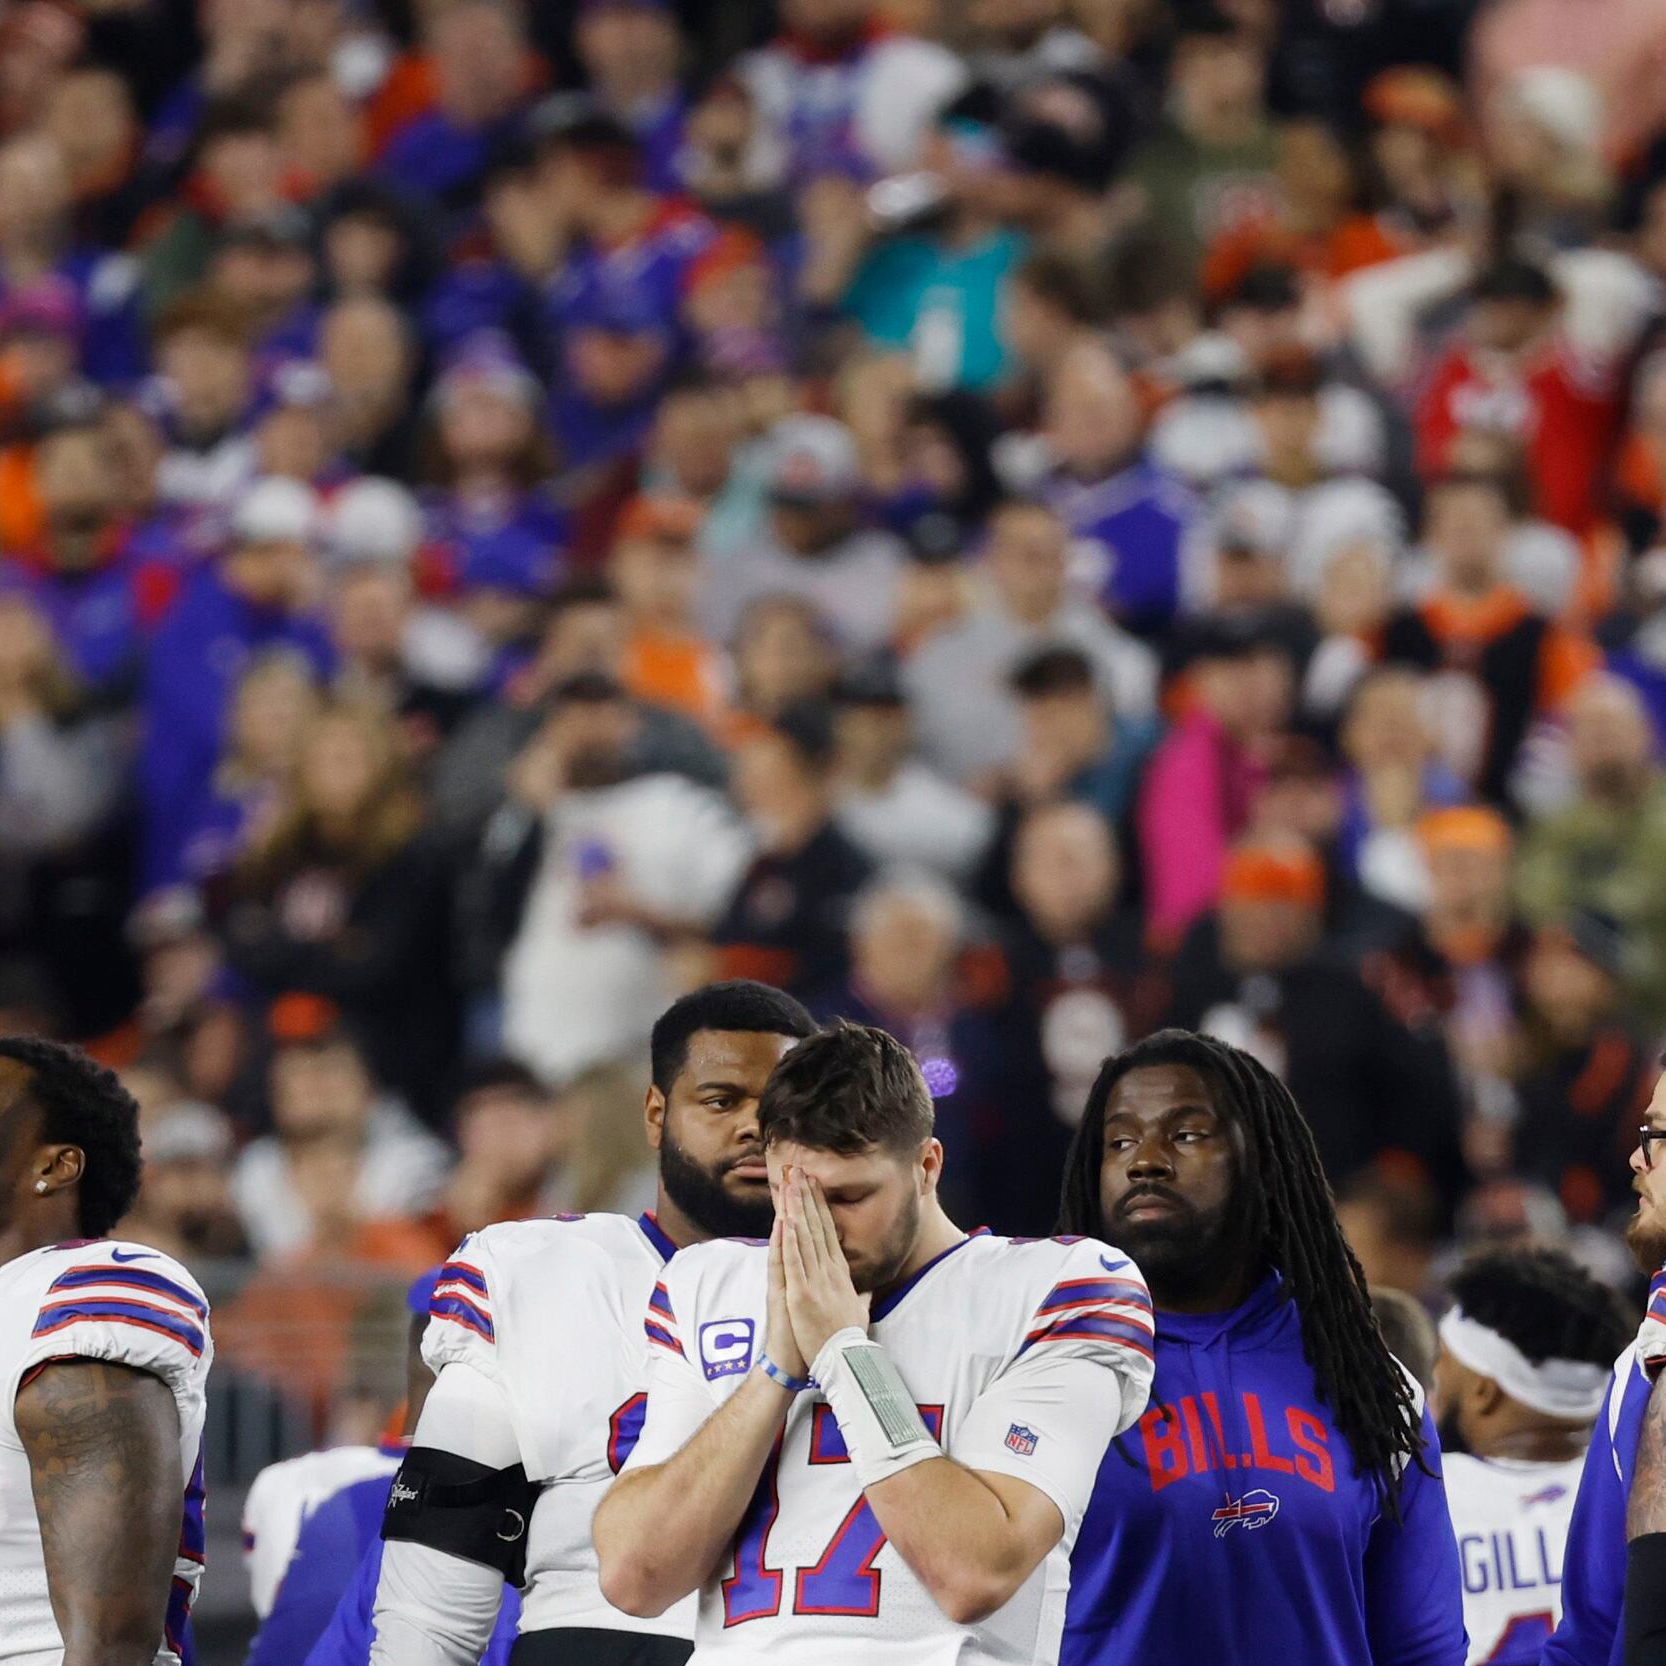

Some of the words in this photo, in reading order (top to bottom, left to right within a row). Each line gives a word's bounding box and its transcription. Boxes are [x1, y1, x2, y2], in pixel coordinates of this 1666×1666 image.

[701, 1321, 751, 1363] C
[1139, 1391, 1335, 1493] BILLS
[721, 1403, 945, 1629] 17
